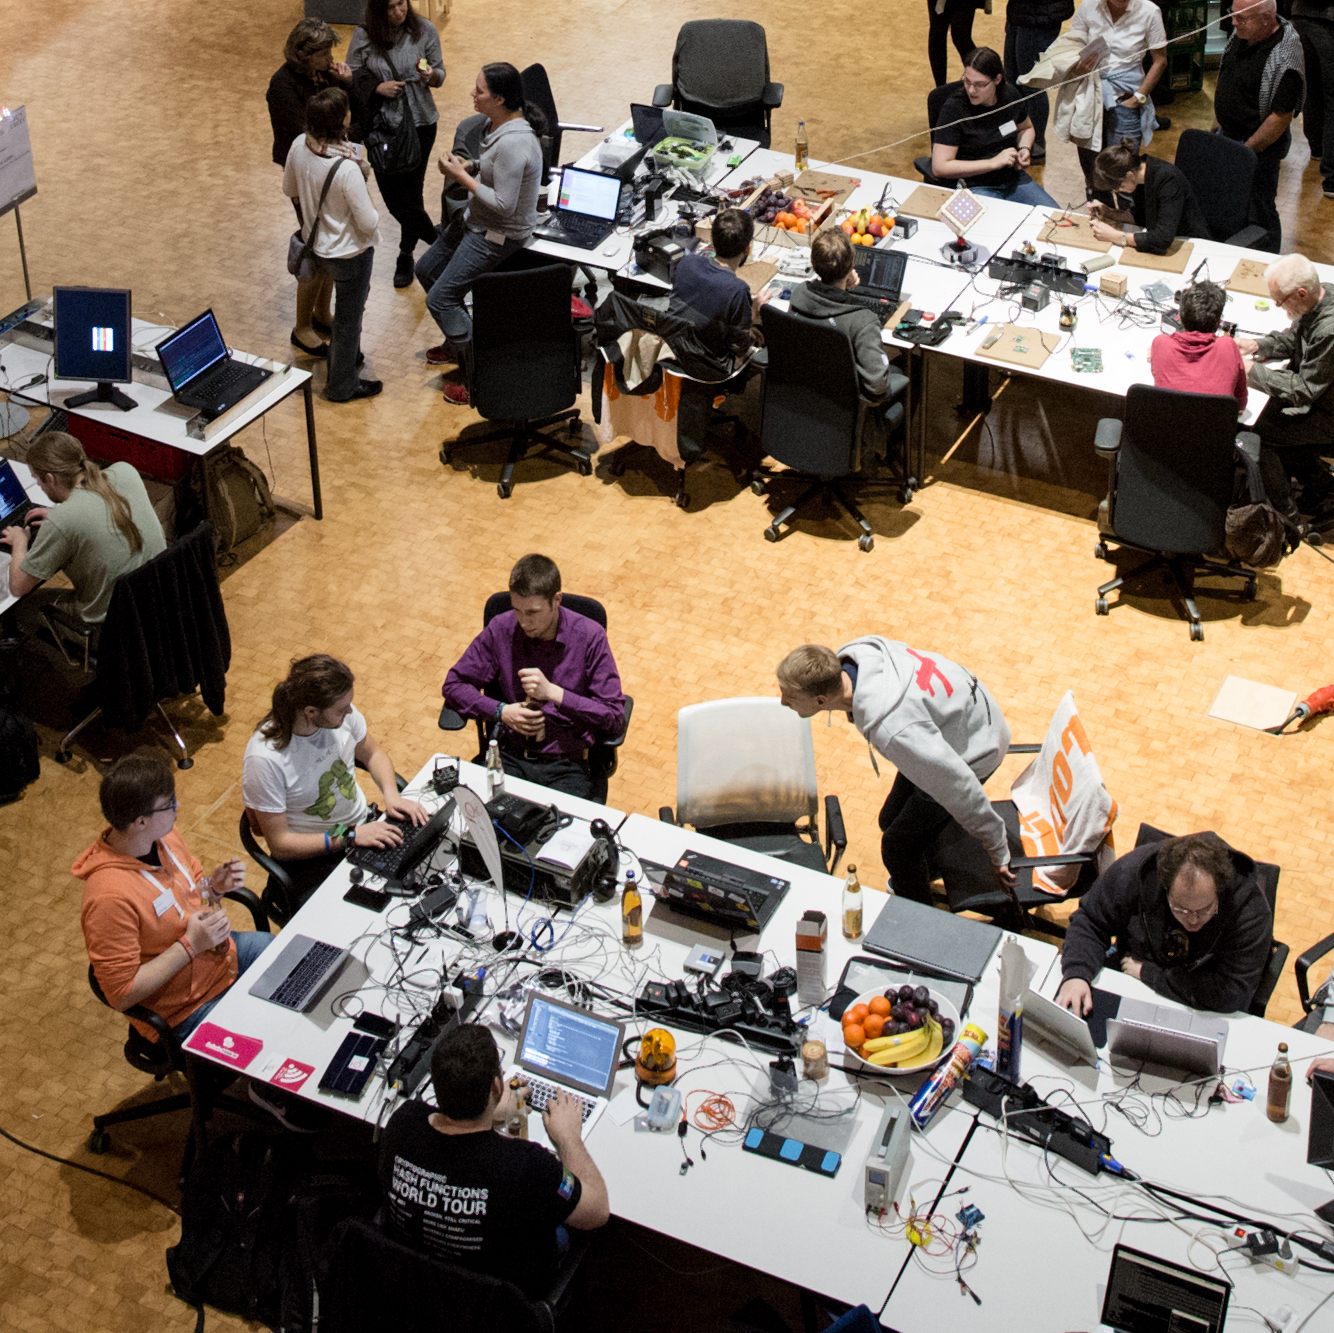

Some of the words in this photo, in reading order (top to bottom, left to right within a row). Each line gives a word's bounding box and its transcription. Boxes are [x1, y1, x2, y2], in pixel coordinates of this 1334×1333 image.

[393, 1164, 419, 1186] HASH
[419, 1177, 489, 1200] FUNCTIONS
[394, 1155, 447, 1183] CRYPTOGRAPHIC
[392, 1176, 438, 1209] WORLD
[442, 1196, 487, 1216] TOUR
